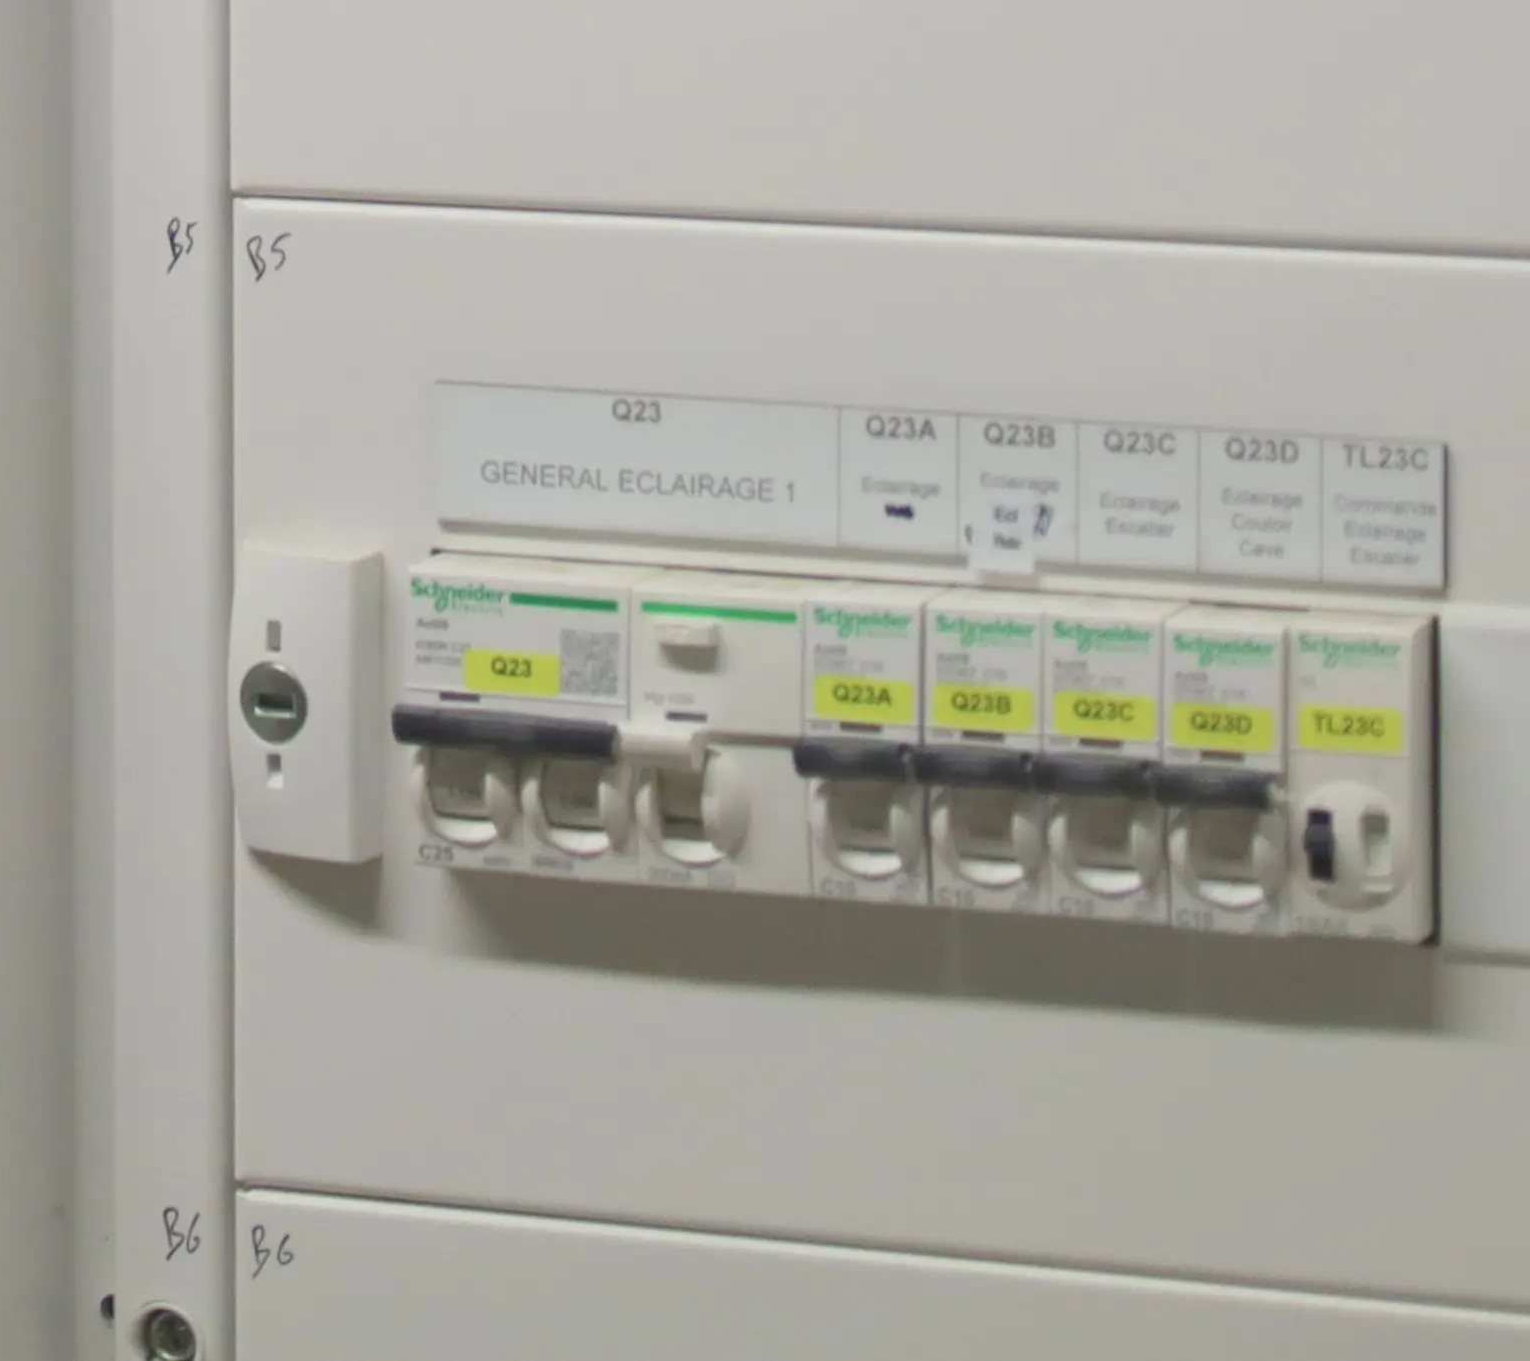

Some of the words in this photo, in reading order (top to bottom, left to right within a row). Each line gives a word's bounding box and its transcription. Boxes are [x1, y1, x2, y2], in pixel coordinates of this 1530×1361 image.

[166, 217, 197, 273] B5
[245, 232, 291, 283] B5
[608, 398, 666, 428] Q23
[862, 412, 939, 443] Q23A
[979, 418, 1060, 452] Q23B
[1099, 429, 1180, 460] Q23C
[1220, 433, 1303, 467] Q23D
[1338, 443, 1432, 475] TL23C
[480, 460, 608, 492] GENERAL
[618, 468, 773, 503] ECLAIRAGE
[786, 482, 795, 503] 1
[410, 578, 506, 612] Schneider
[488, 653, 536, 678] Q23
[829, 679, 896, 710] Q23A
[948, 687, 1015, 718] Q23B
[1070, 696, 1139, 727] Q23C
[1187, 707, 1257, 738] Q23D
[1314, 709, 1389, 742] TL23C
[162, 1206, 201, 1262] B6
[251, 1224, 294, 1279] B6
